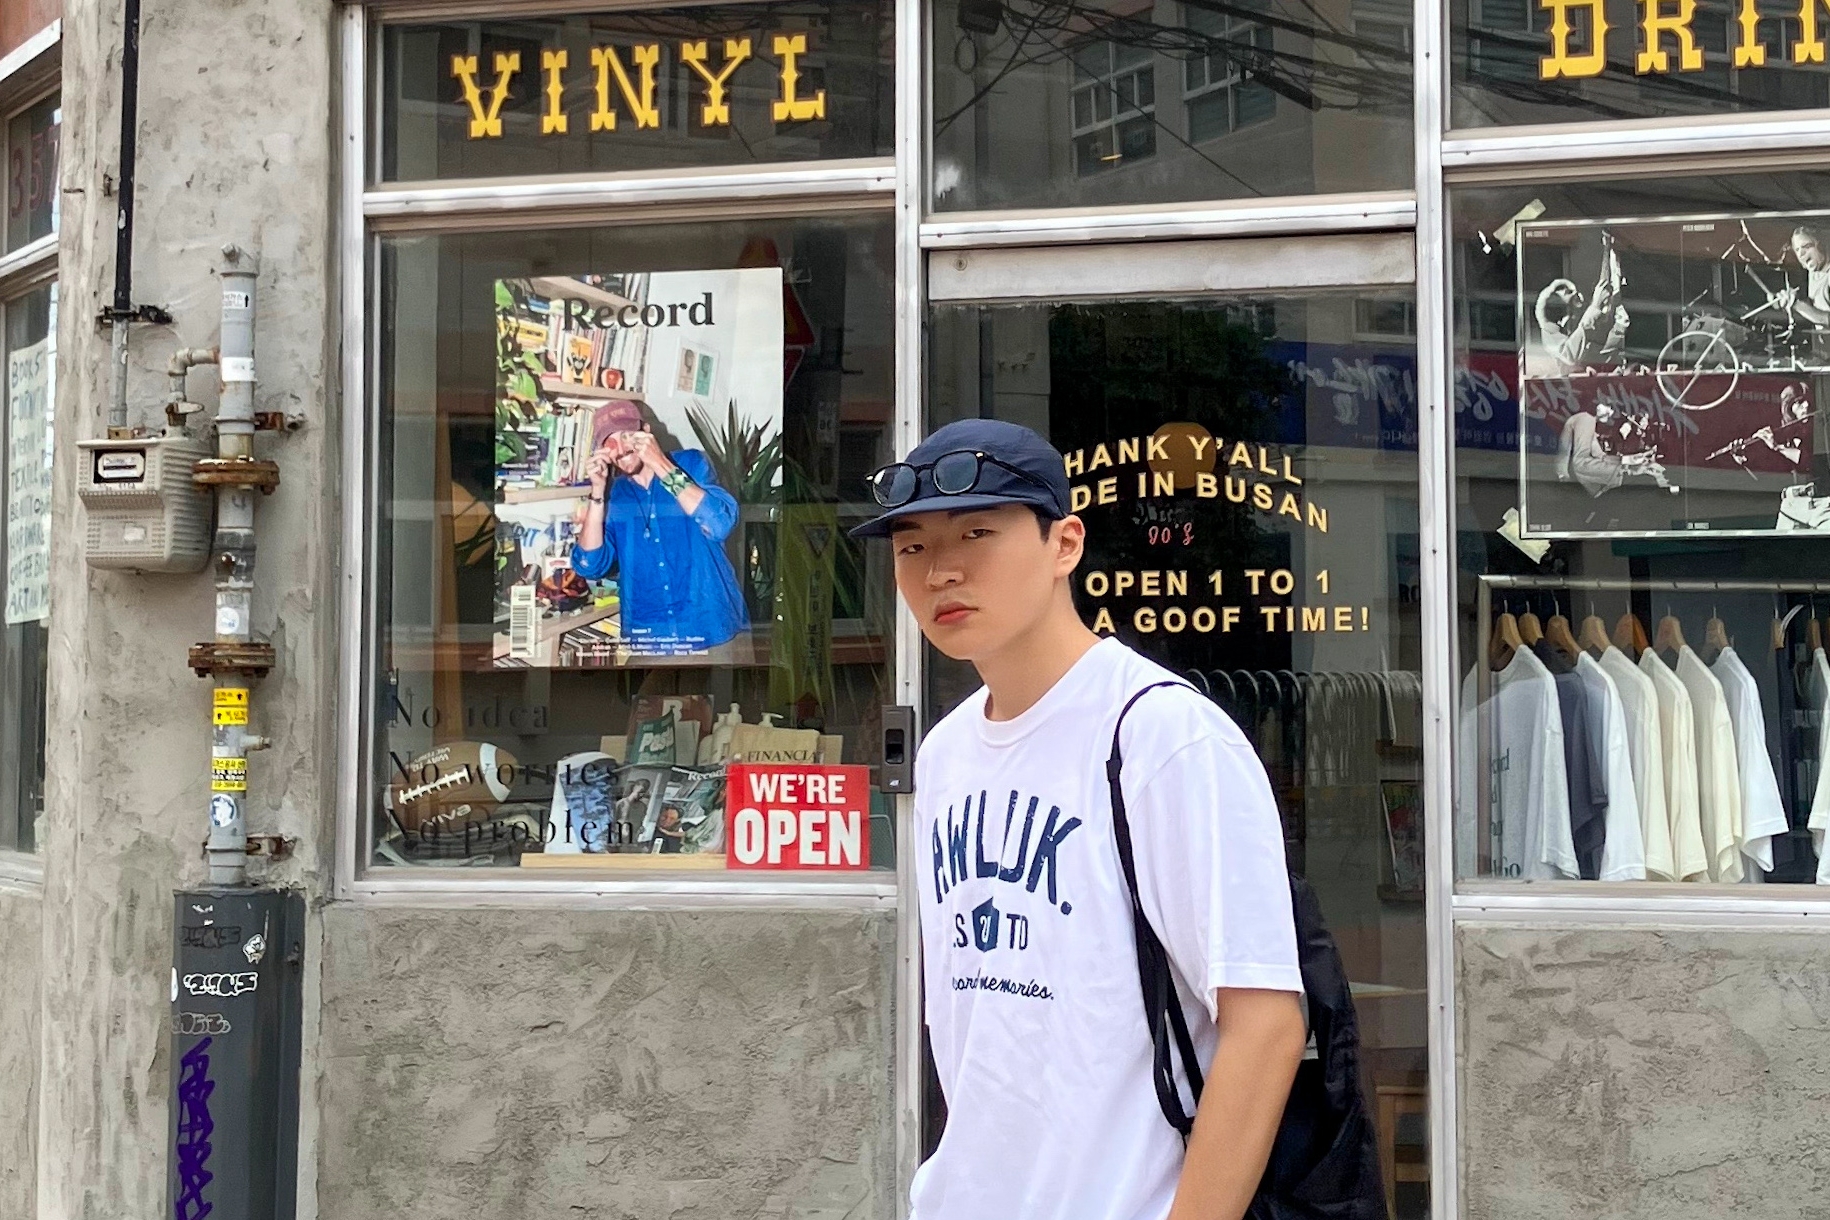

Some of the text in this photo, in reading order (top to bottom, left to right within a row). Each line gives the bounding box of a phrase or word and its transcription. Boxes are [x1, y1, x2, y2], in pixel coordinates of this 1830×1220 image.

[451, 33, 827, 140] VINYL
[562, 292, 716, 332] Record
[1187, 434, 1303, 486] Y'ALL
[1138, 471, 1175, 498] IN
[1196, 471, 1329, 533] BUSAN
[1085, 568, 1330, 597] OPEN 1 TO 1
[1092, 606, 1370, 633] A GOOF TIME!
[388, 692, 549, 728] No idea
[389, 750, 620, 785] No worries
[749, 773, 847, 804] WE'RE
[388, 808, 636, 855] No problem
[734, 808, 862, 866] OPEN
